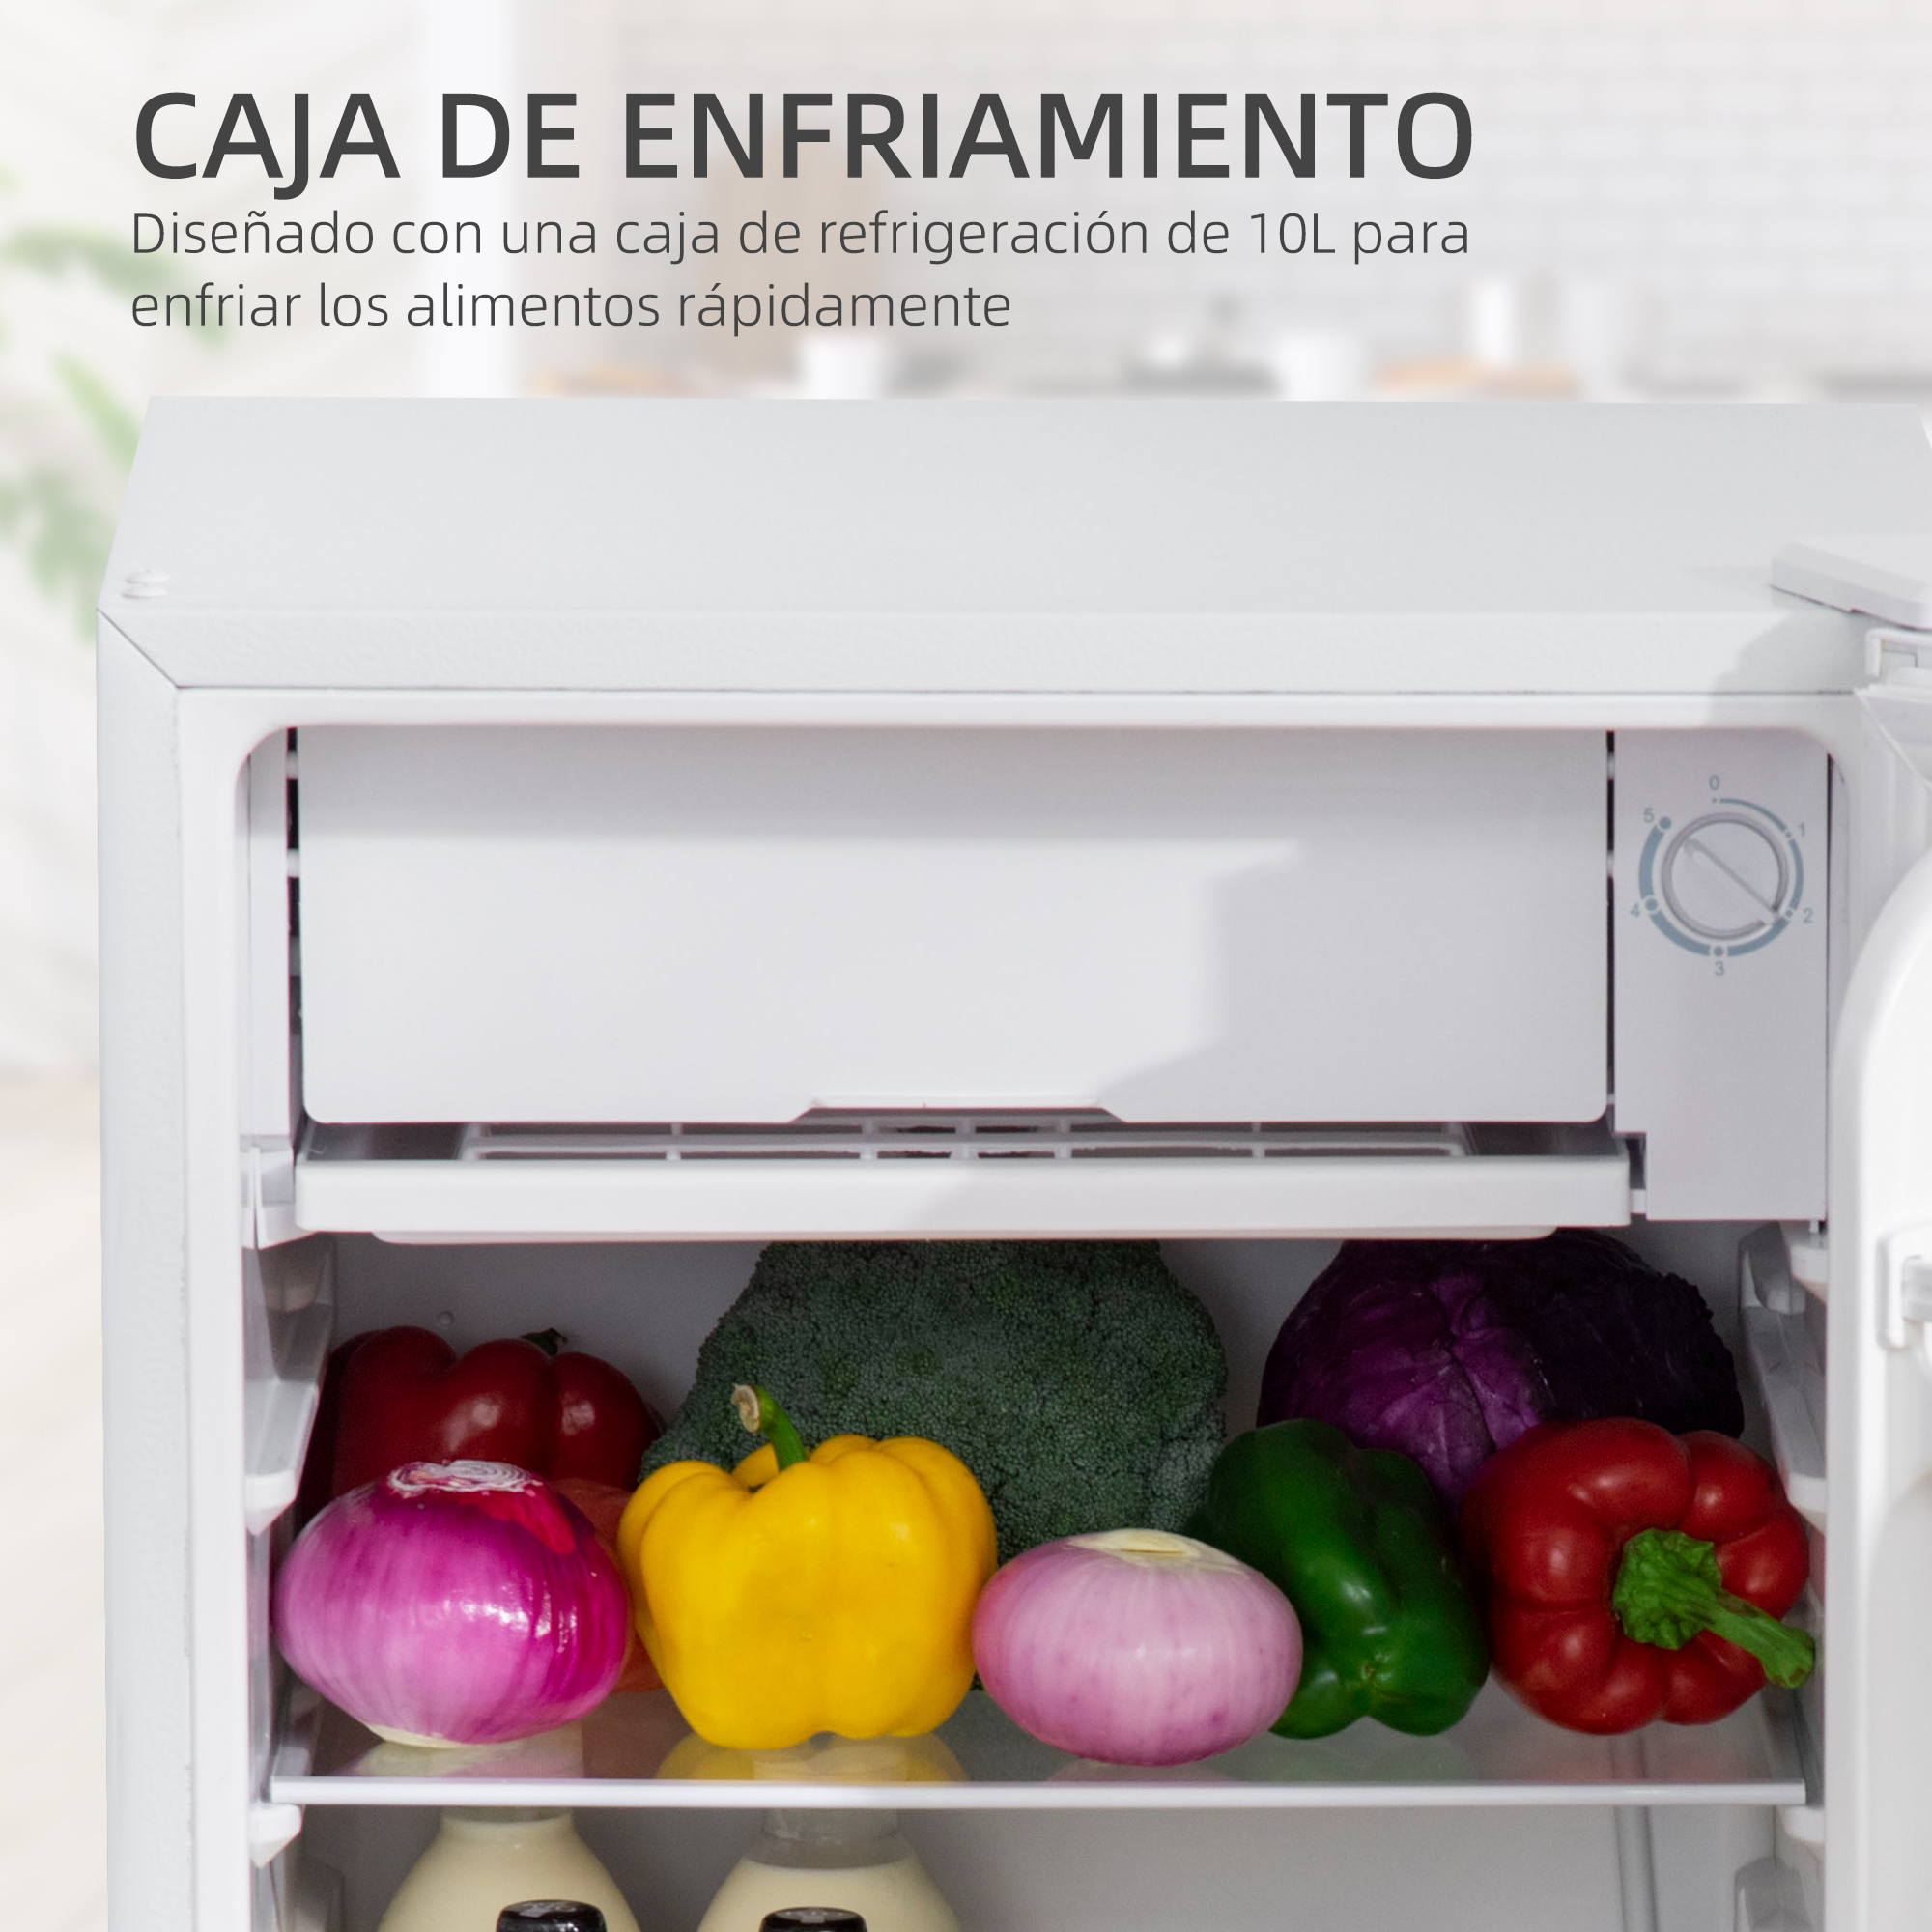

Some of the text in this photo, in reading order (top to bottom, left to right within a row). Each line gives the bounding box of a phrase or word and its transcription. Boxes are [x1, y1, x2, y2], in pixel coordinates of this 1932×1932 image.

[1644, 808, 1655, 823] 5
[1798, 822, 1805, 837] 1
[1630, 902, 1641, 918] 4
[1803, 907, 1813, 923] 2
[1715, 960, 1724, 977] 3
